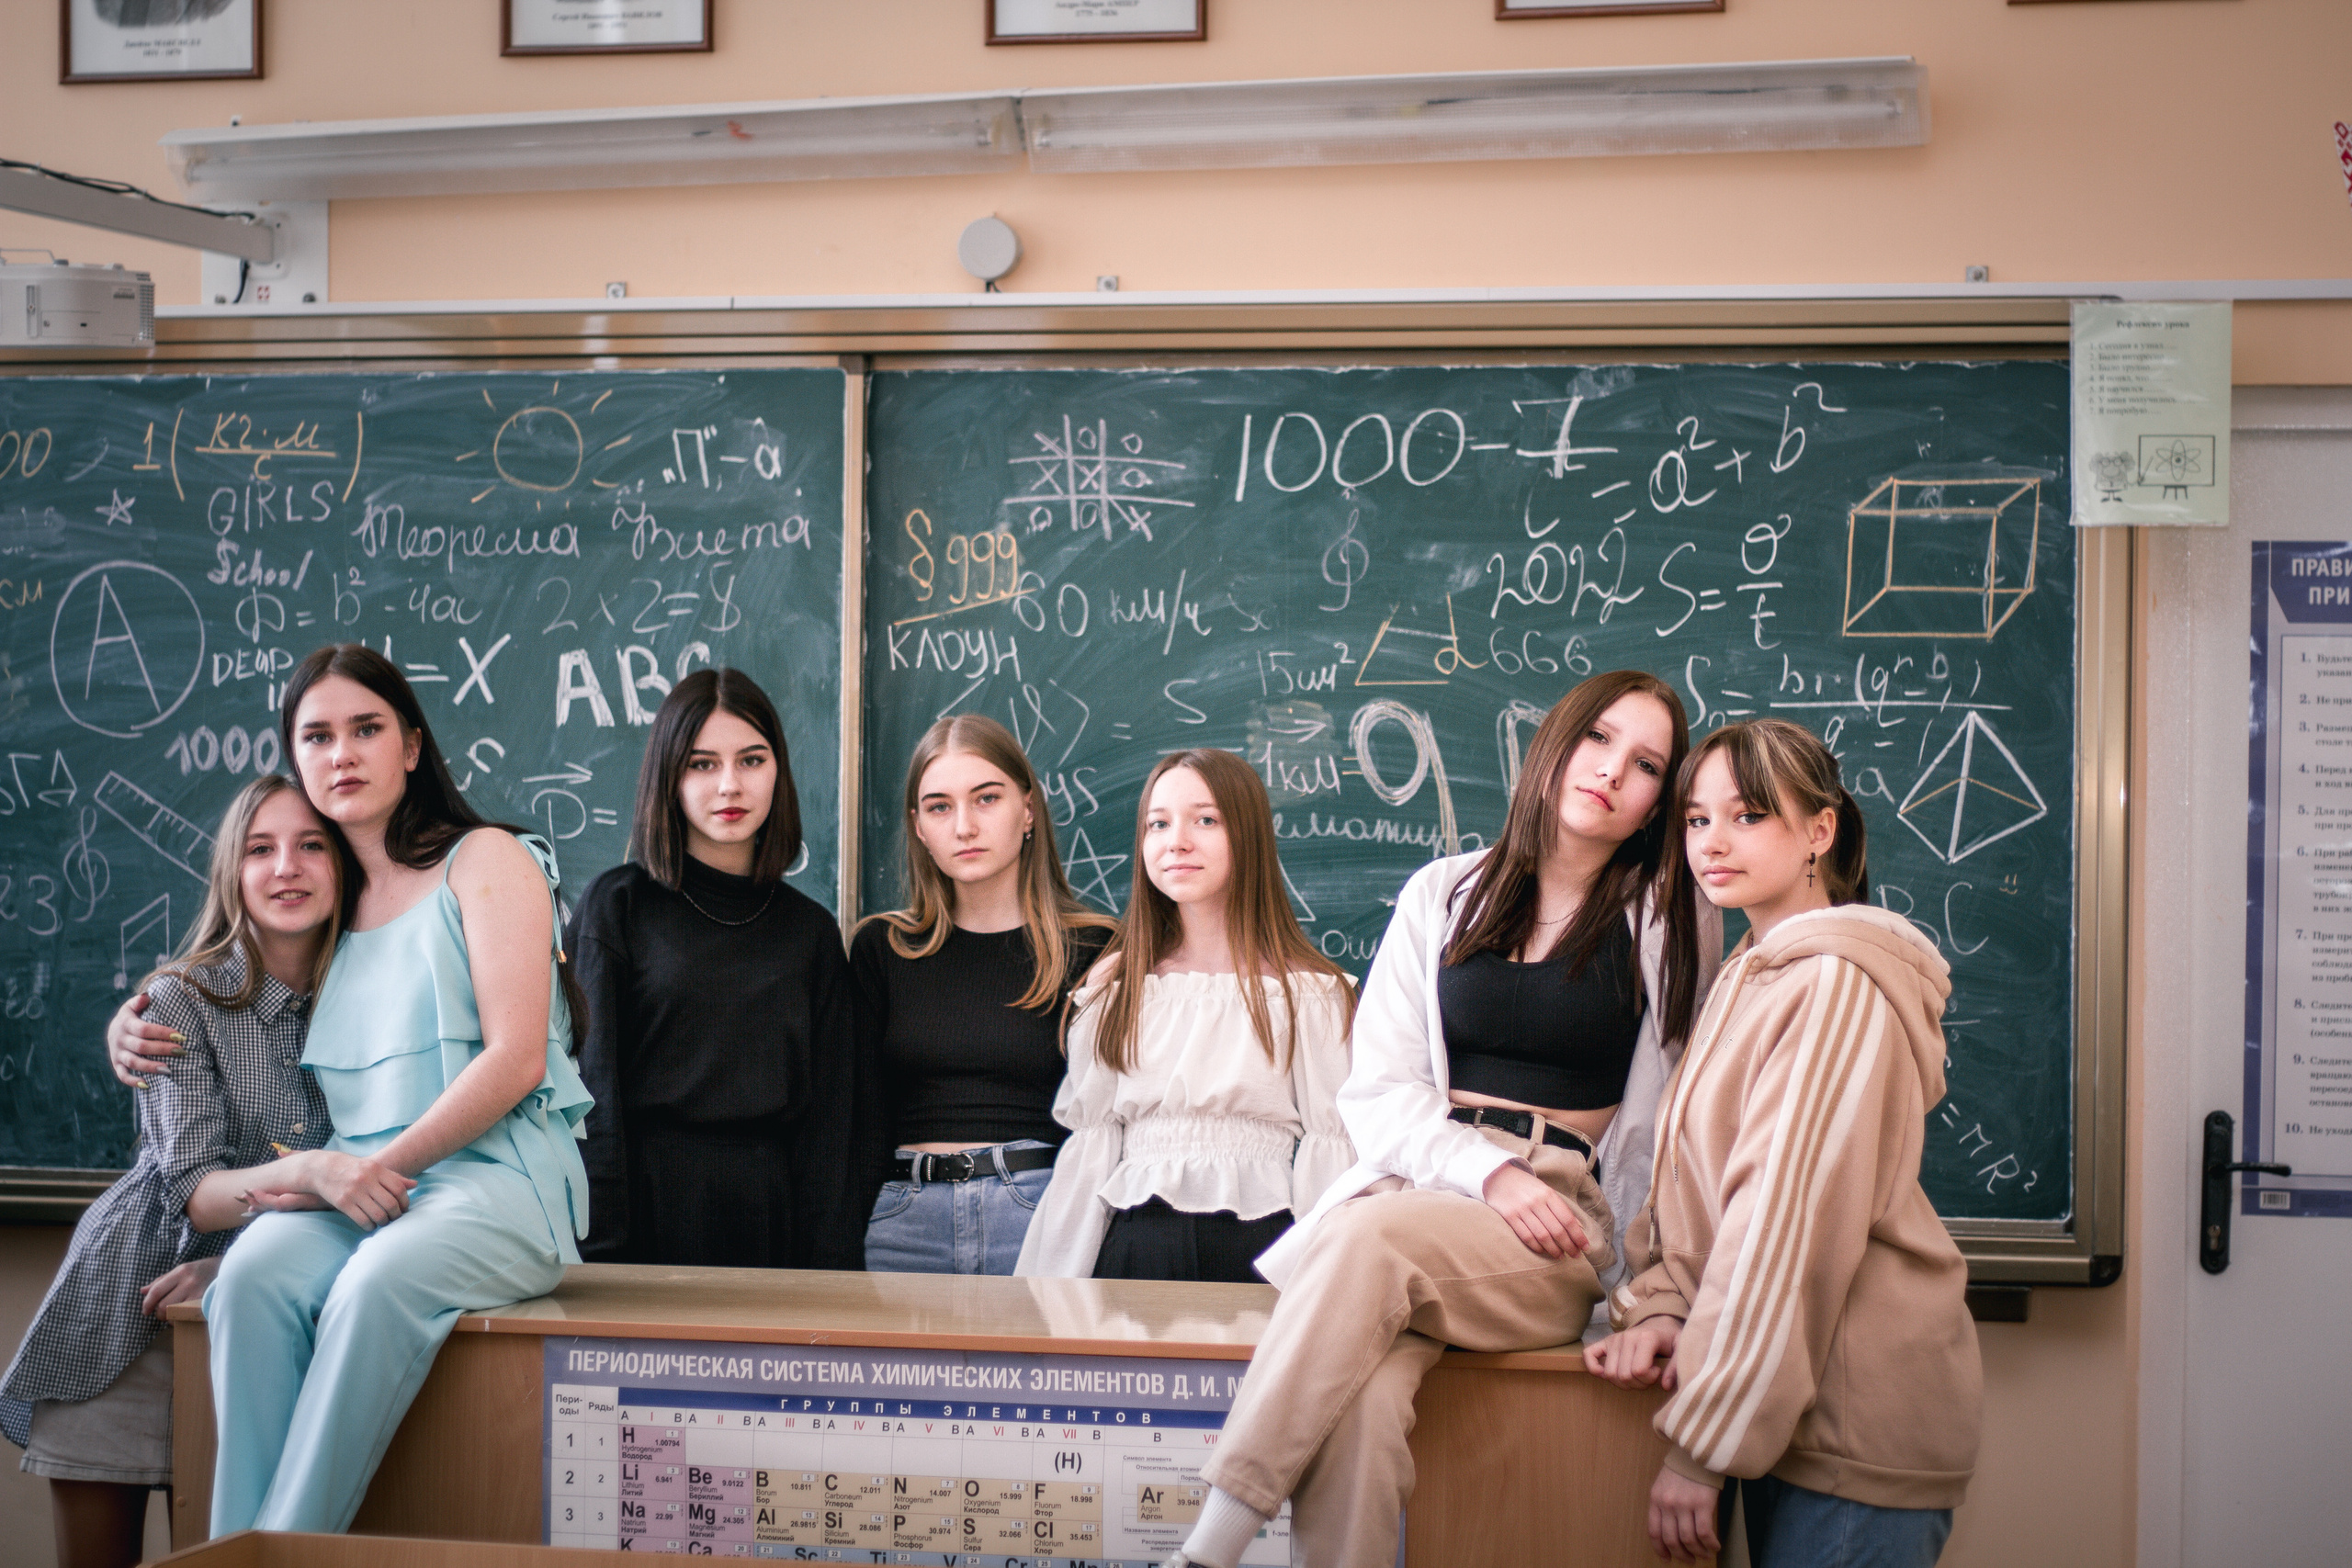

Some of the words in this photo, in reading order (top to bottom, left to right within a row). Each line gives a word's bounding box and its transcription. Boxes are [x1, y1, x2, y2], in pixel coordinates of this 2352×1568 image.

[207, 479, 334, 536] GIRLS
[2309, 586, 2350, 605] ПРИ
[1488, 626, 1593, 677] 666
[569, 1349, 753, 1379] ПЕРИОДИЧЕСКАЯ
[761, 1359, 865, 1384] СИСТЕМА
[871, 1363, 1023, 1390] ХИМИЧЕСКИХ
[1030, 1368, 1164, 1394] ЭЛЕМЕНТОВ
[1172, 1374, 1193, 1400] Д.
[1200, 1376, 1220, 1397] И.
[588, 1402, 615, 1412] Ряды
[718, 1415, 724, 1425] II
[786, 1418, 795, 1427] III
[854, 1421, 865, 1431] IV
[993, 1426, 1004, 1437] VI
[1063, 1429, 1077, 1439] VII
[566, 1433, 573, 1448] 1
[599, 1438, 604, 1446] 1
[623, 1427, 634, 1444] H
[655, 1439, 680, 1448] 1.00794
[621, 1445, 662, 1453] Hydrogenium
[1055, 1451, 1082, 1474] (H)
[566, 1471, 574, 1484] 2
[598, 1474, 605, 1483] 2
[623, 1464, 638, 1481] Li
[689, 1468, 712, 1484] Be
[756, 1471, 769, 1487] B
[825, 1473, 838, 1491] C
[894, 1477, 906, 1494] N
[965, 1480, 979, 1497] O
[689, 1485, 718, 1494] Beryllium
[825, 1492, 862, 1500] Carboneum
[1035, 1483, 1046, 1499] F
[1141, 1486, 1164, 1504] Ar
[689, 1493, 724, 1501] Бериллий
[756, 1496, 770, 1505] Бор
[894, 1495, 933, 1505] Nitrogenium
[963, 1499, 1001, 1507] Oxygenium
[621, 1501, 645, 1517] Na
[825, 1500, 854, 1508] Углерод
[963, 1506, 1000, 1515] Кислород
[1035, 1501, 1062, 1510] Fluorum
[1141, 1506, 1161, 1514] Argon
[566, 1508, 573, 1521] 3
[597, 1512, 604, 1521] 3
[689, 1504, 715, 1525] Mg
[757, 1508, 775, 1525] Al
[689, 1523, 726, 1532] Magnesium
[825, 1512, 842, 1529] Si
[859, 1524, 882, 1532] 28.086
[894, 1516, 906, 1532] P
[963, 1517, 976, 1535] S
[689, 1530, 715, 1539] Магний
[1035, 1521, 1053, 1538] Cl
[825, 1538, 856, 1546] Кремний
[893, 1533, 933, 1542] Phosphorus
[893, 1541, 923, 1550] Фосфор
[963, 1544, 981, 1552] Сера
[1035, 1547, 1053, 1555] Хлор
